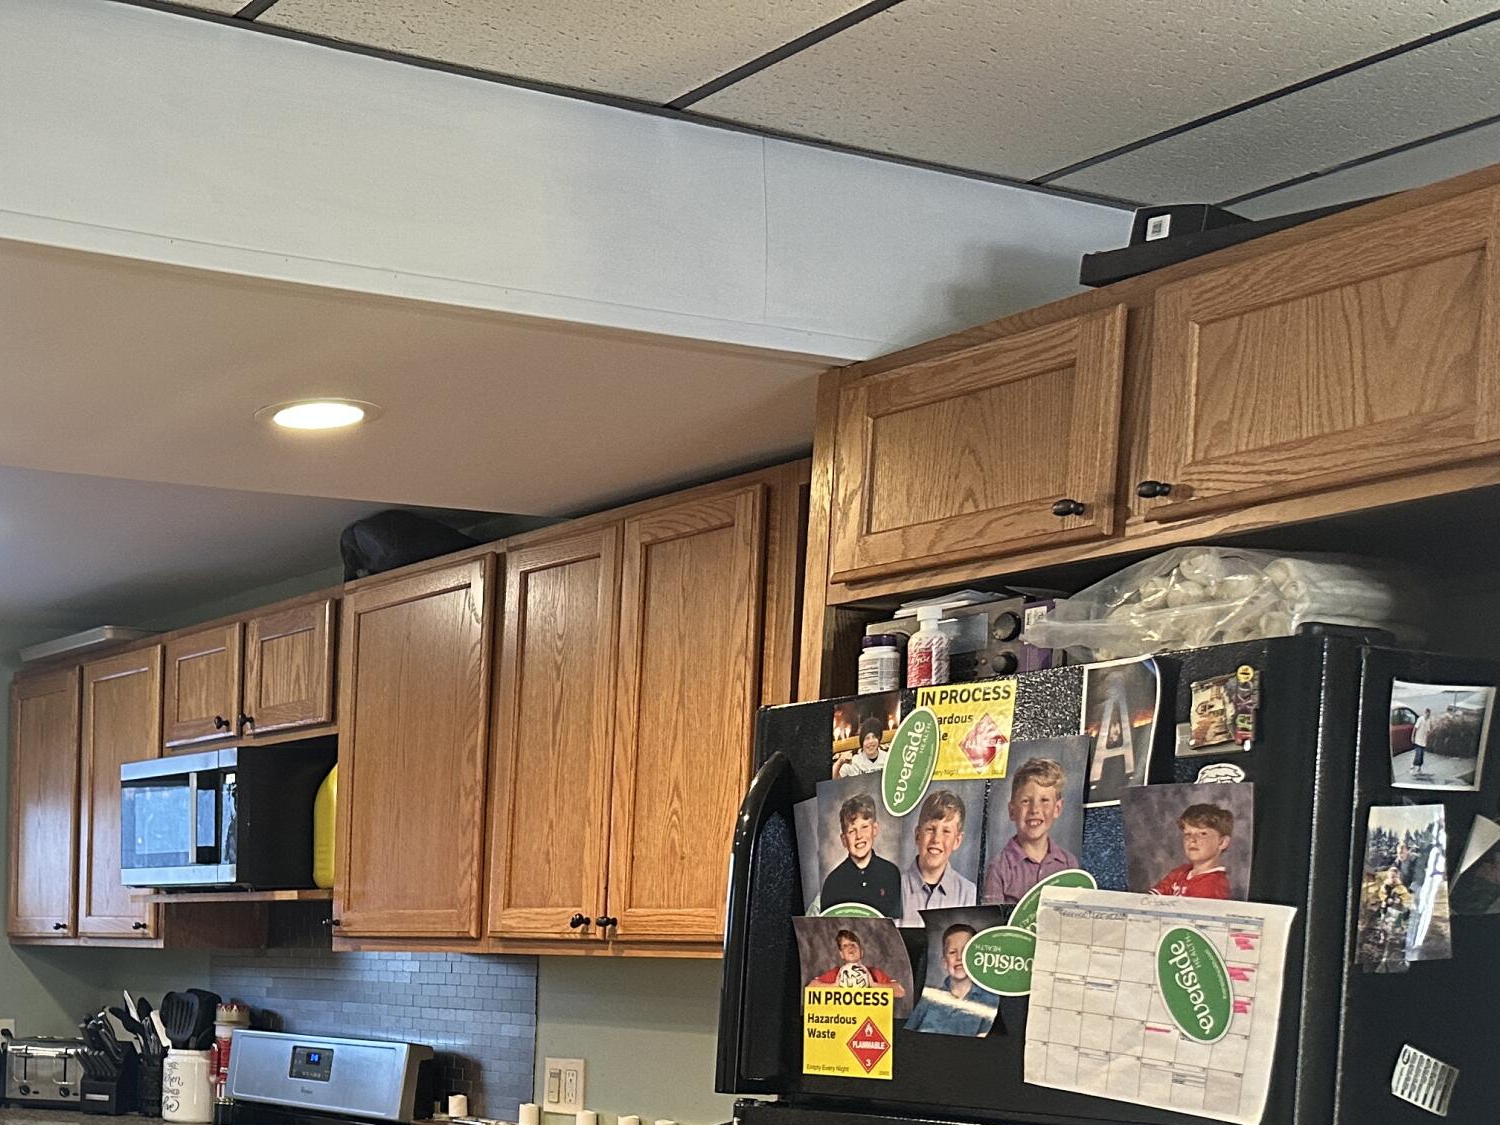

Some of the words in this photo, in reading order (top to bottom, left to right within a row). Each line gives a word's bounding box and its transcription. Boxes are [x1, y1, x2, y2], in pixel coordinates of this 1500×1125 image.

[920, 691, 936, 706] IN
[938, 684, 1012, 705] PROCESS
[937, 714, 974, 725] ardous
[893, 720, 927, 807] everside
[973, 951, 1034, 975] verside
[1167, 939, 1214, 1035] everside
[808, 990, 821, 1005] IN
[824, 991, 889, 1006] PROCESS
[807, 1013, 857, 1025] Hazardous
[807, 1028, 836, 1039] Waste
[865, 1058, 872, 1067] 3
